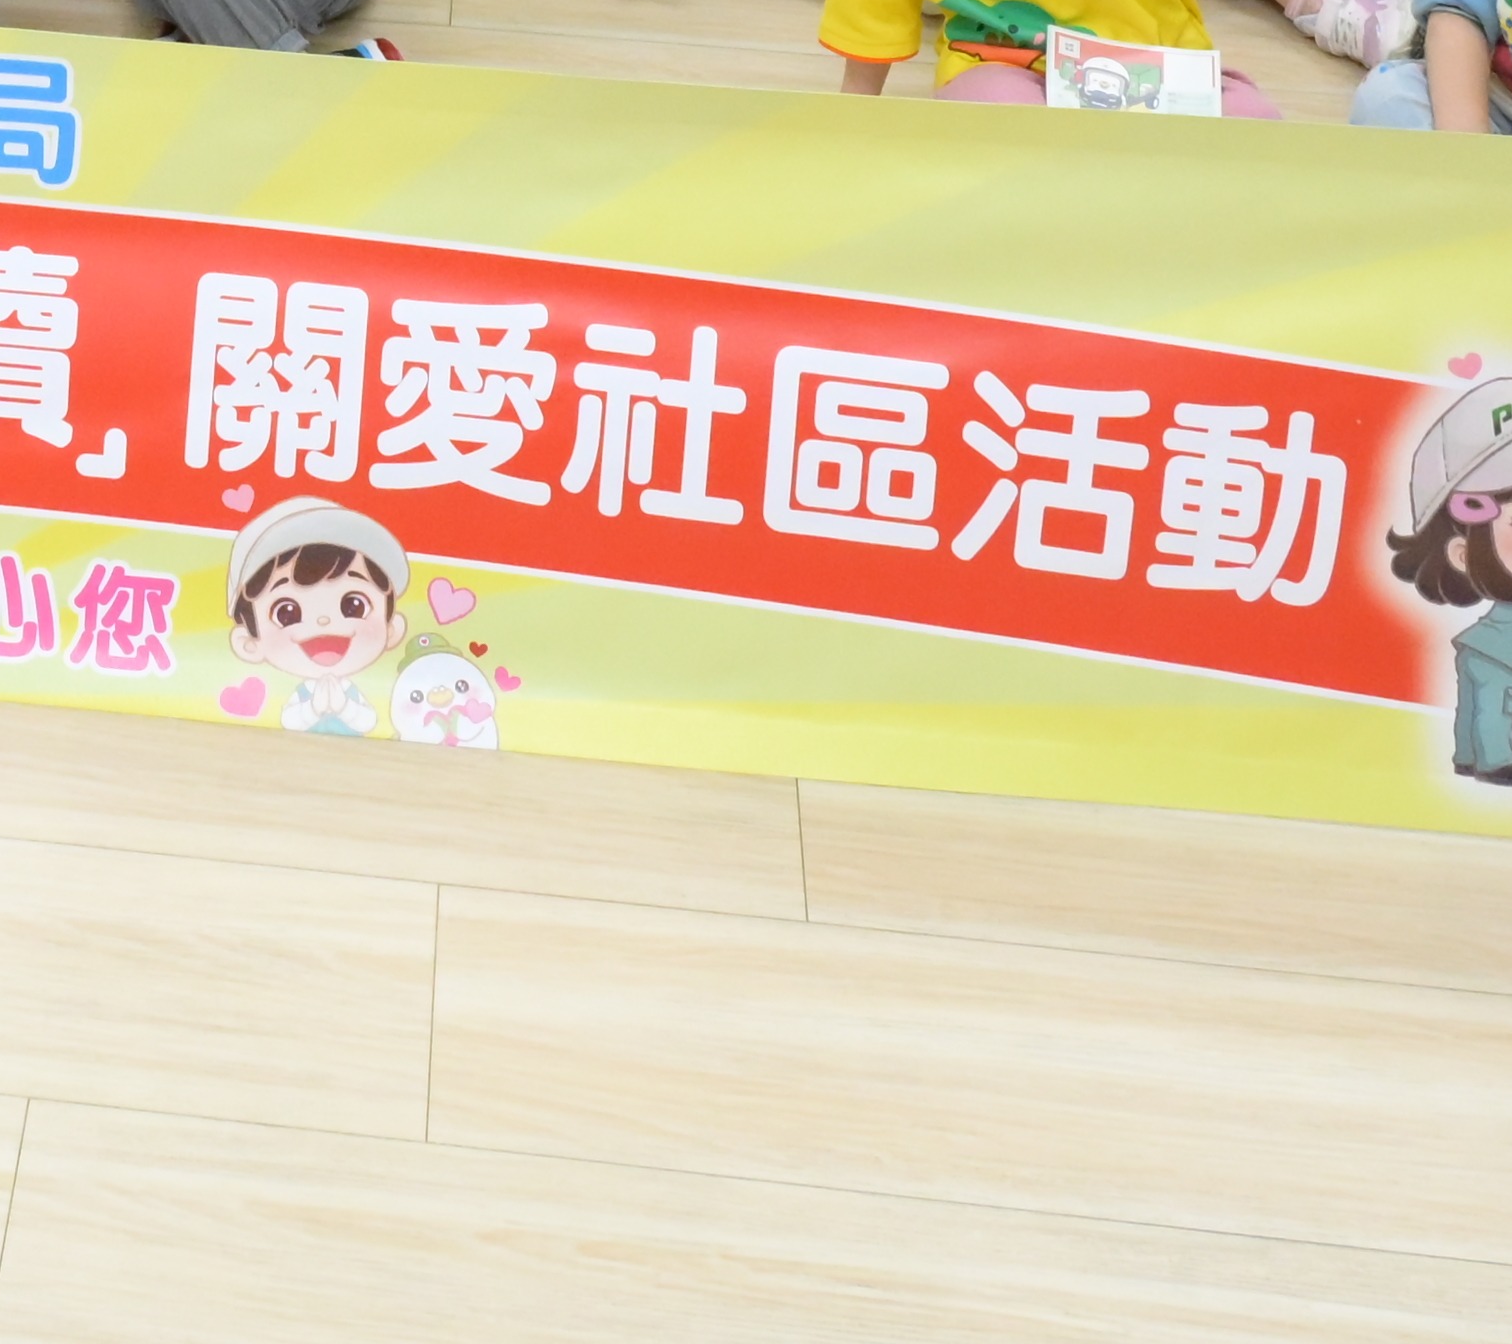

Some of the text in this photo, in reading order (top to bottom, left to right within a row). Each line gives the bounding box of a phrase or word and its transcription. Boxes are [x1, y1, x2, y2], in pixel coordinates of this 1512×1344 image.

[184, 270, 1350, 610] 關愛社區活動
